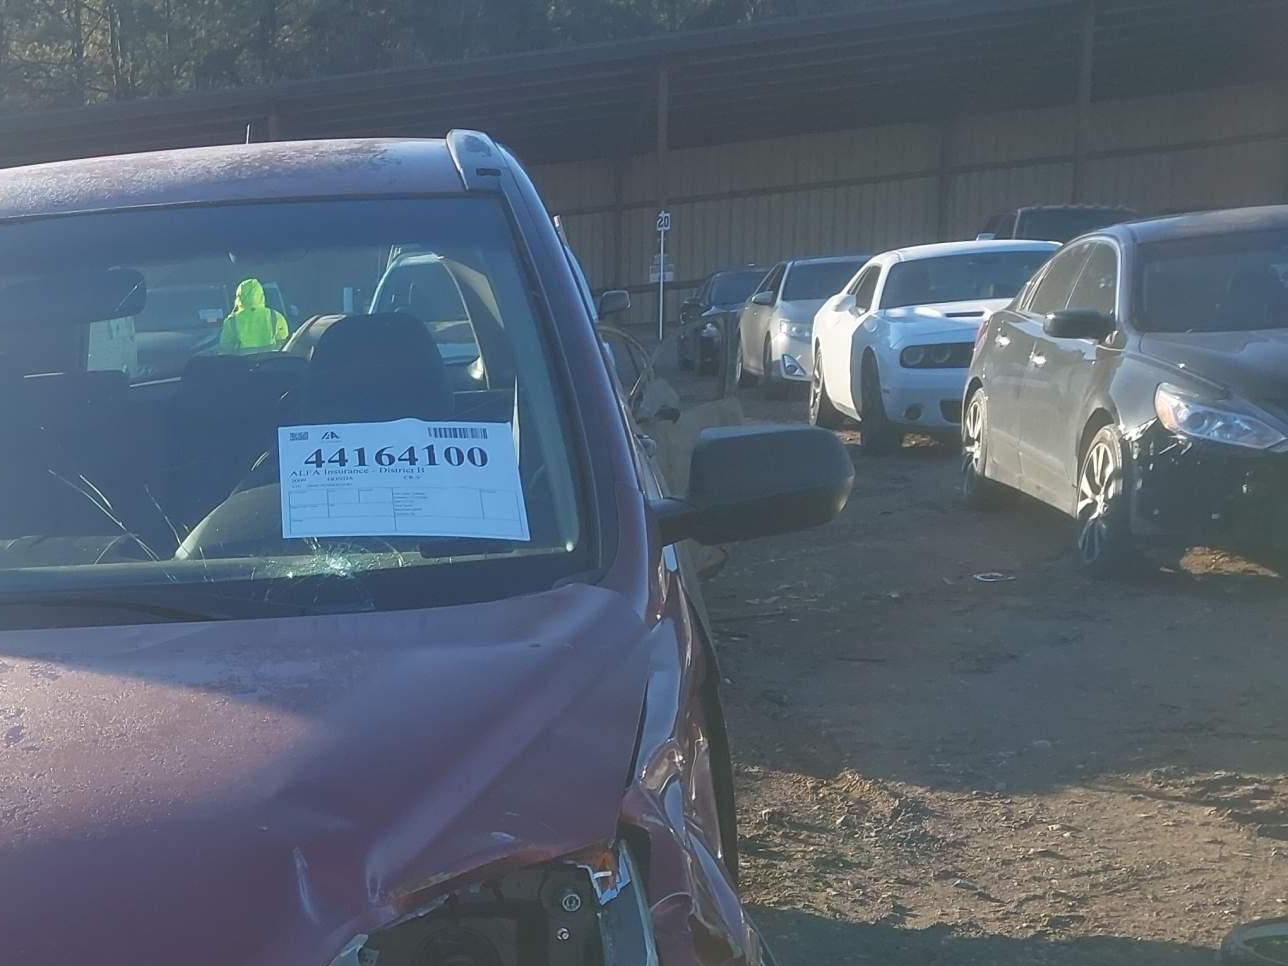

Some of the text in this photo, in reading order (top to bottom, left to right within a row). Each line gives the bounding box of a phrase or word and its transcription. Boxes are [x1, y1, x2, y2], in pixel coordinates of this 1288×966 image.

[657, 215, 669, 228] 20
[304, 444, 488, 468] 44164100
[324, 468, 369, 476] Insurance
